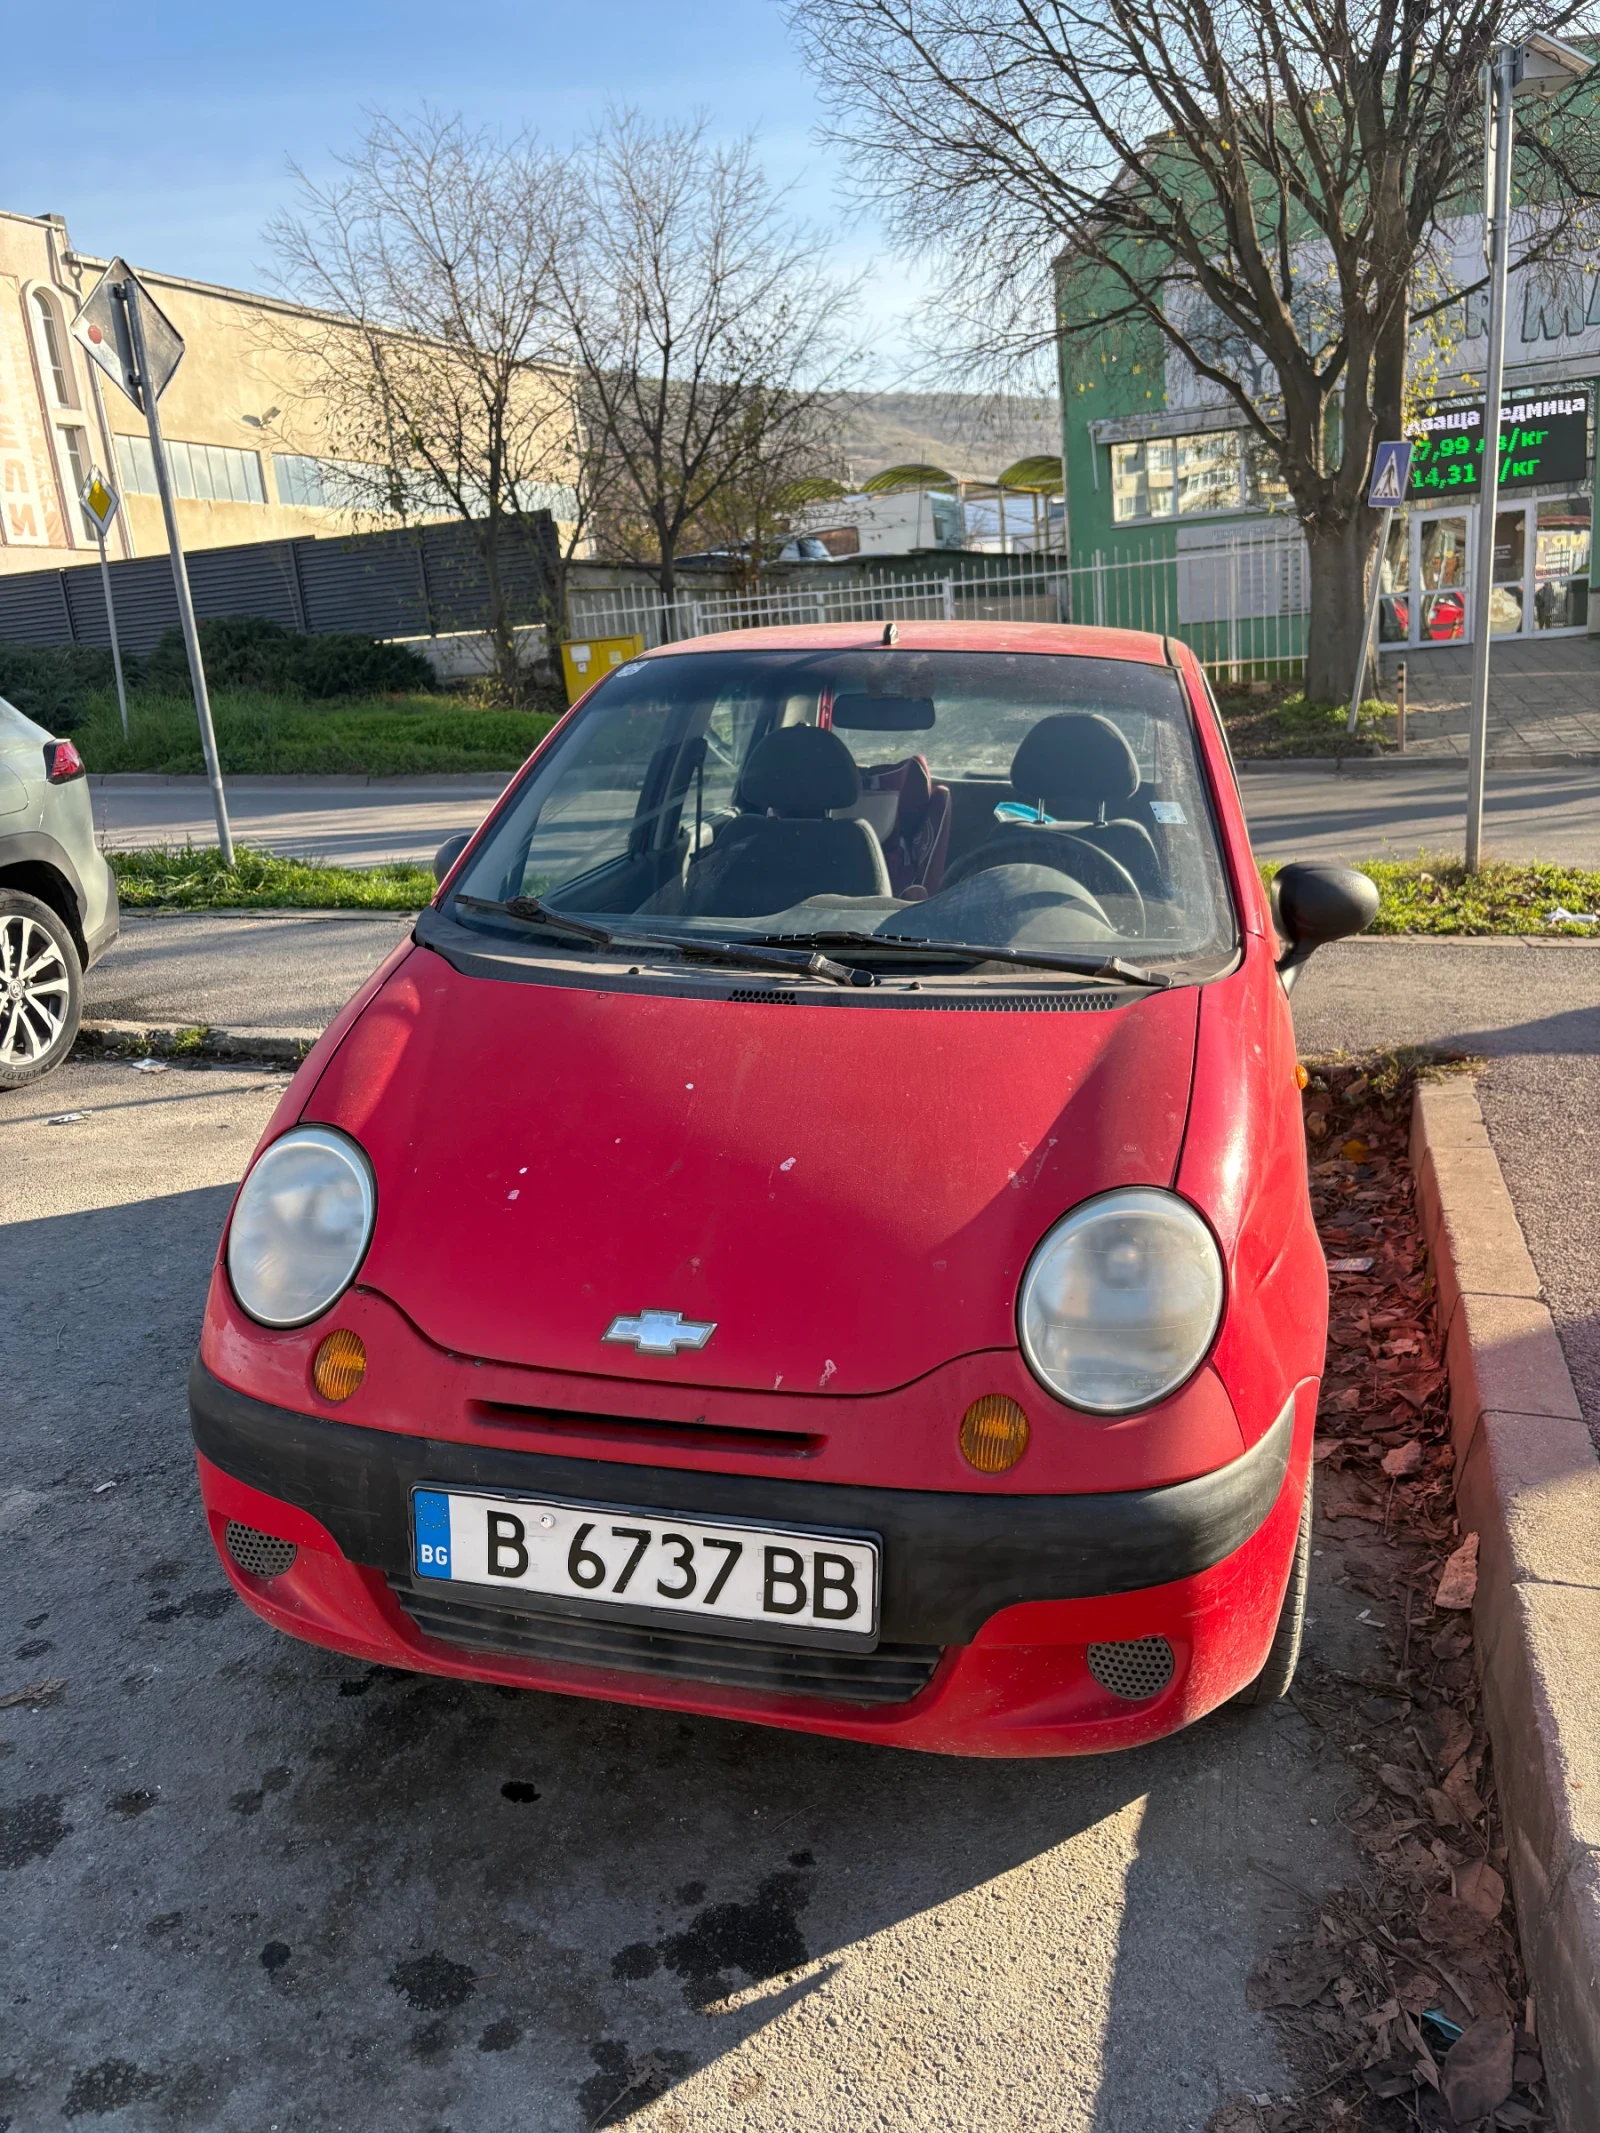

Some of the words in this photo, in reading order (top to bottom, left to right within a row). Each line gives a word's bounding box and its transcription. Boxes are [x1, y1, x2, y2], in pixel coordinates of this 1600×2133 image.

[1500, 397, 1586, 425] едмица
[1498, 457, 1541, 484] /кг
[420, 1543, 448, 1566] BG
[486, 1509, 530, 1578] B
[567, 1522, 743, 1605] 6737
[763, 1545, 859, 1620] BB
